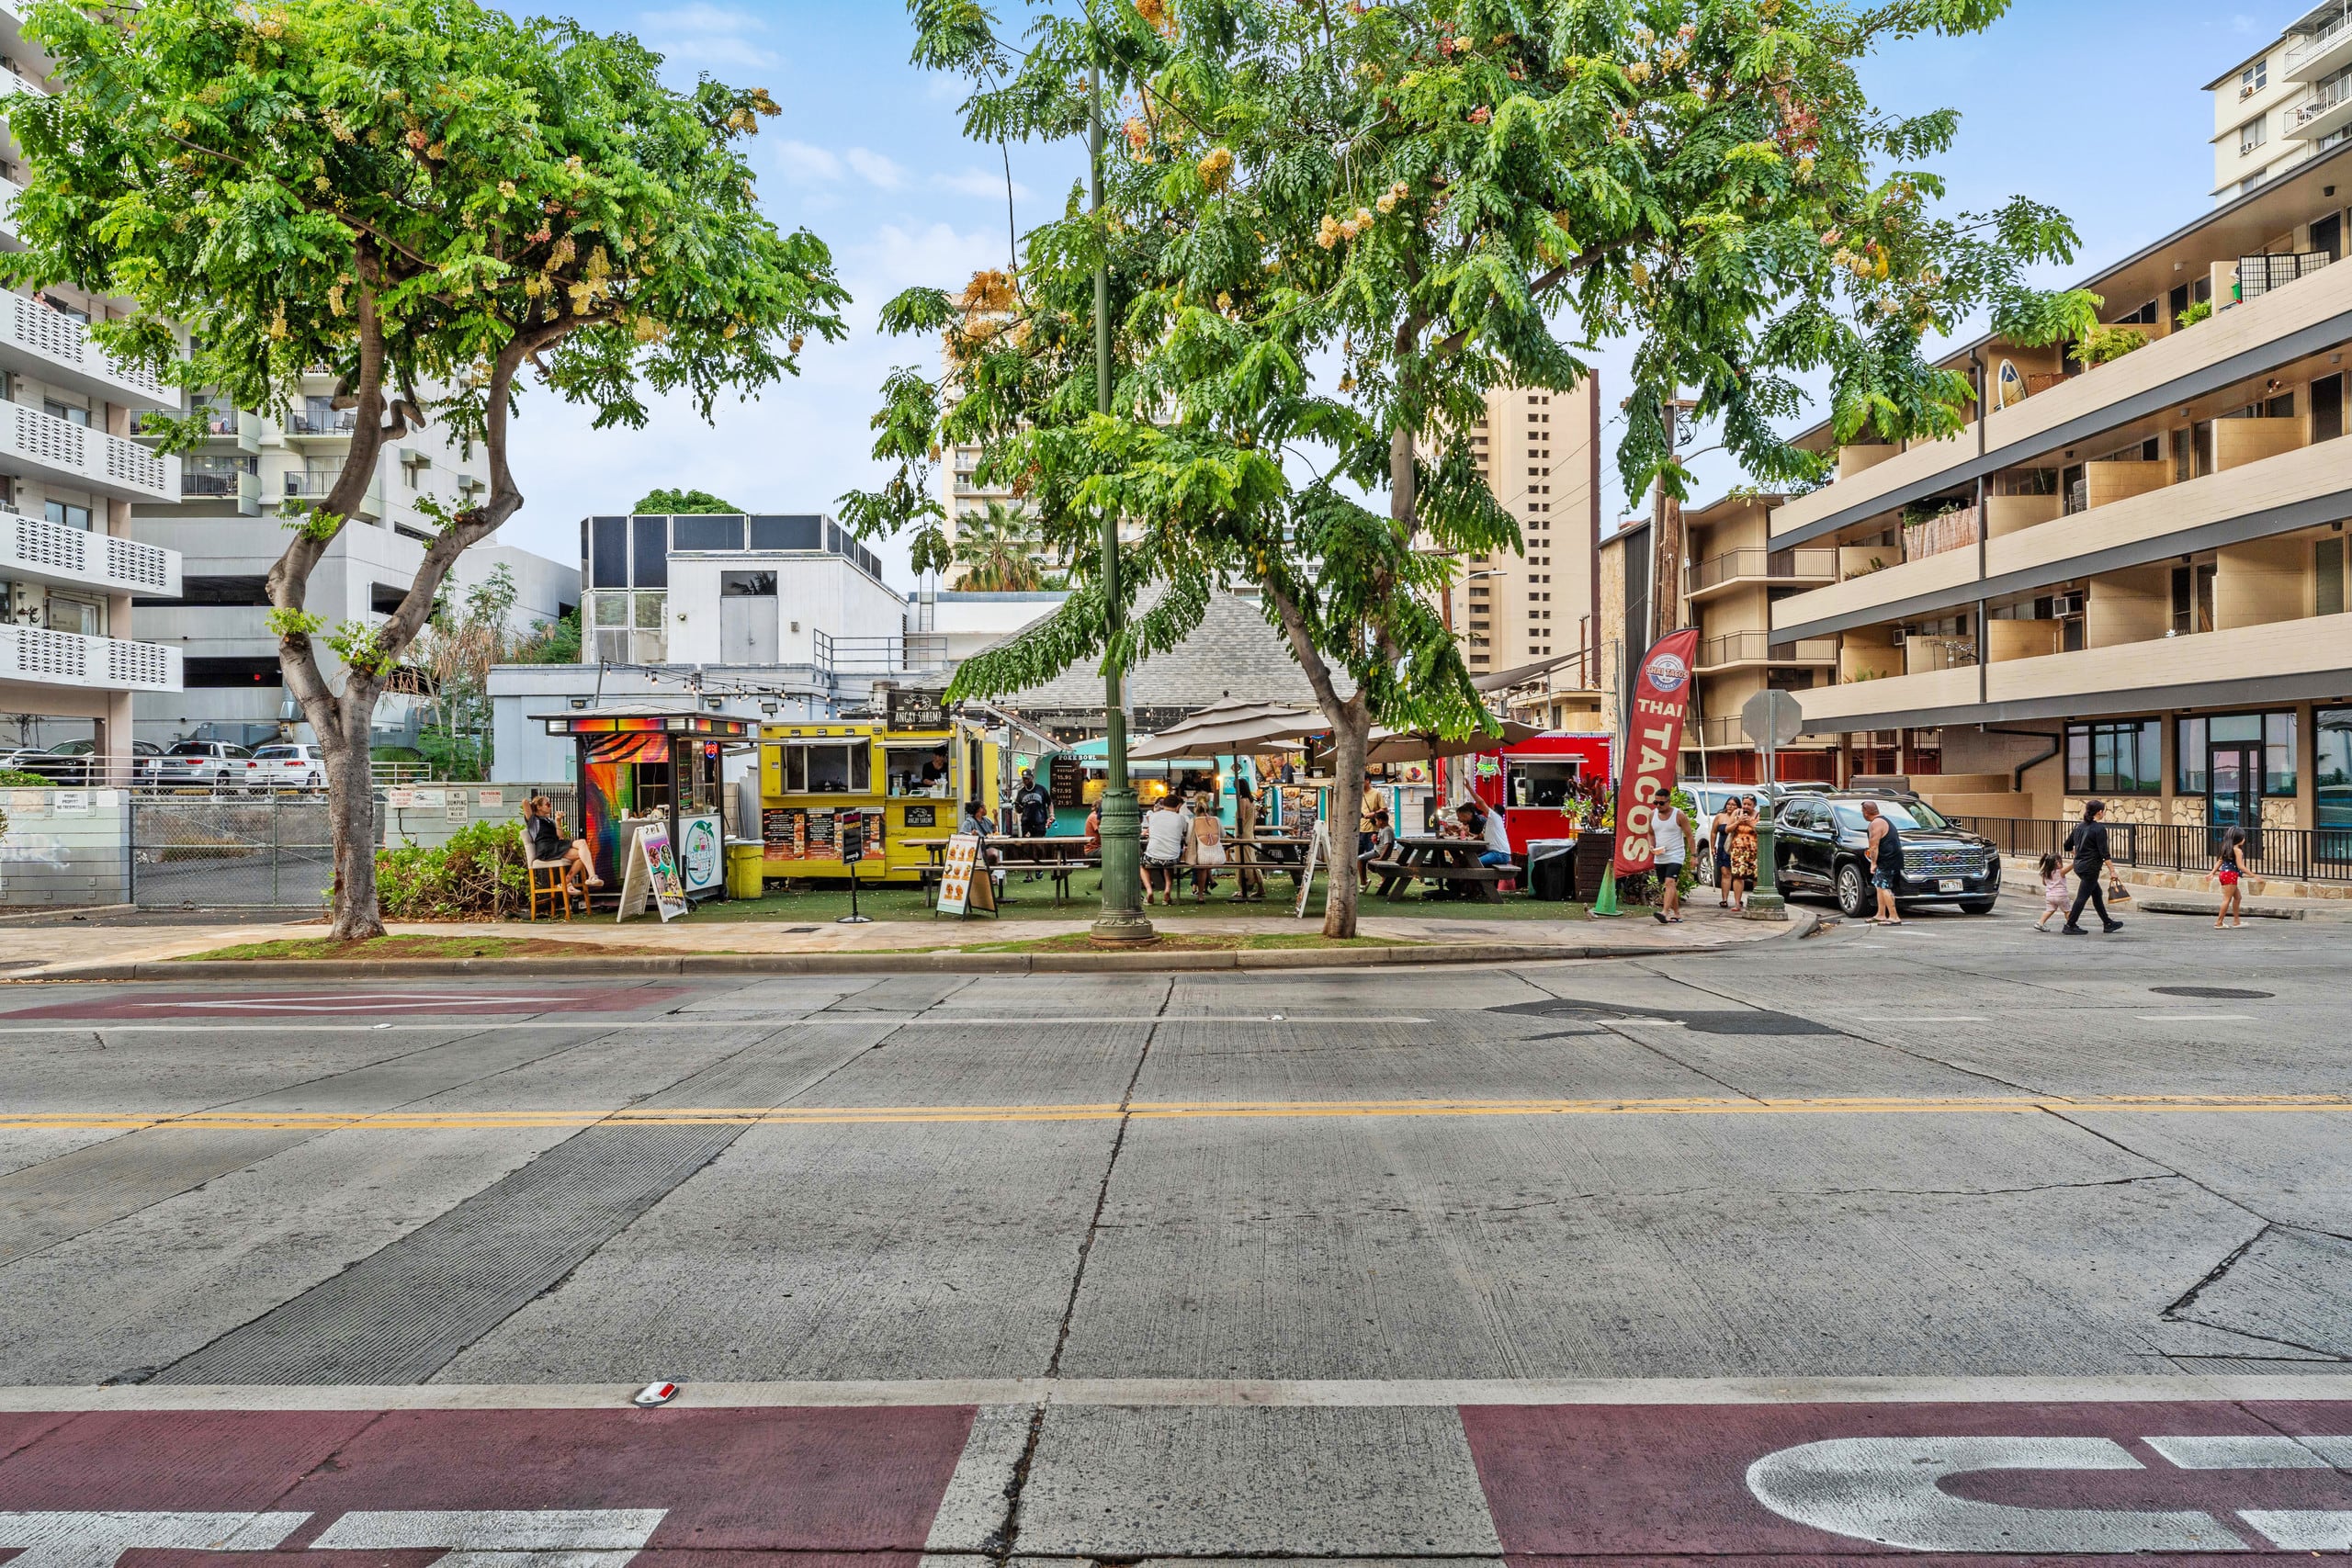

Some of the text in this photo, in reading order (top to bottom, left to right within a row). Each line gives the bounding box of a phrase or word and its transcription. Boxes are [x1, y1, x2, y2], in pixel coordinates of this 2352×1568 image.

[1646, 666, 1688, 679] THAI TACOS
[1656, 680, 1677, 689] WAIKIKI
[1637, 698, 1683, 717] THAI
[895, 711, 942, 723] ANGRY SHRIMP
[706, 744, 718, 754] OPEN
[1623, 723, 1673, 863] TACOS
